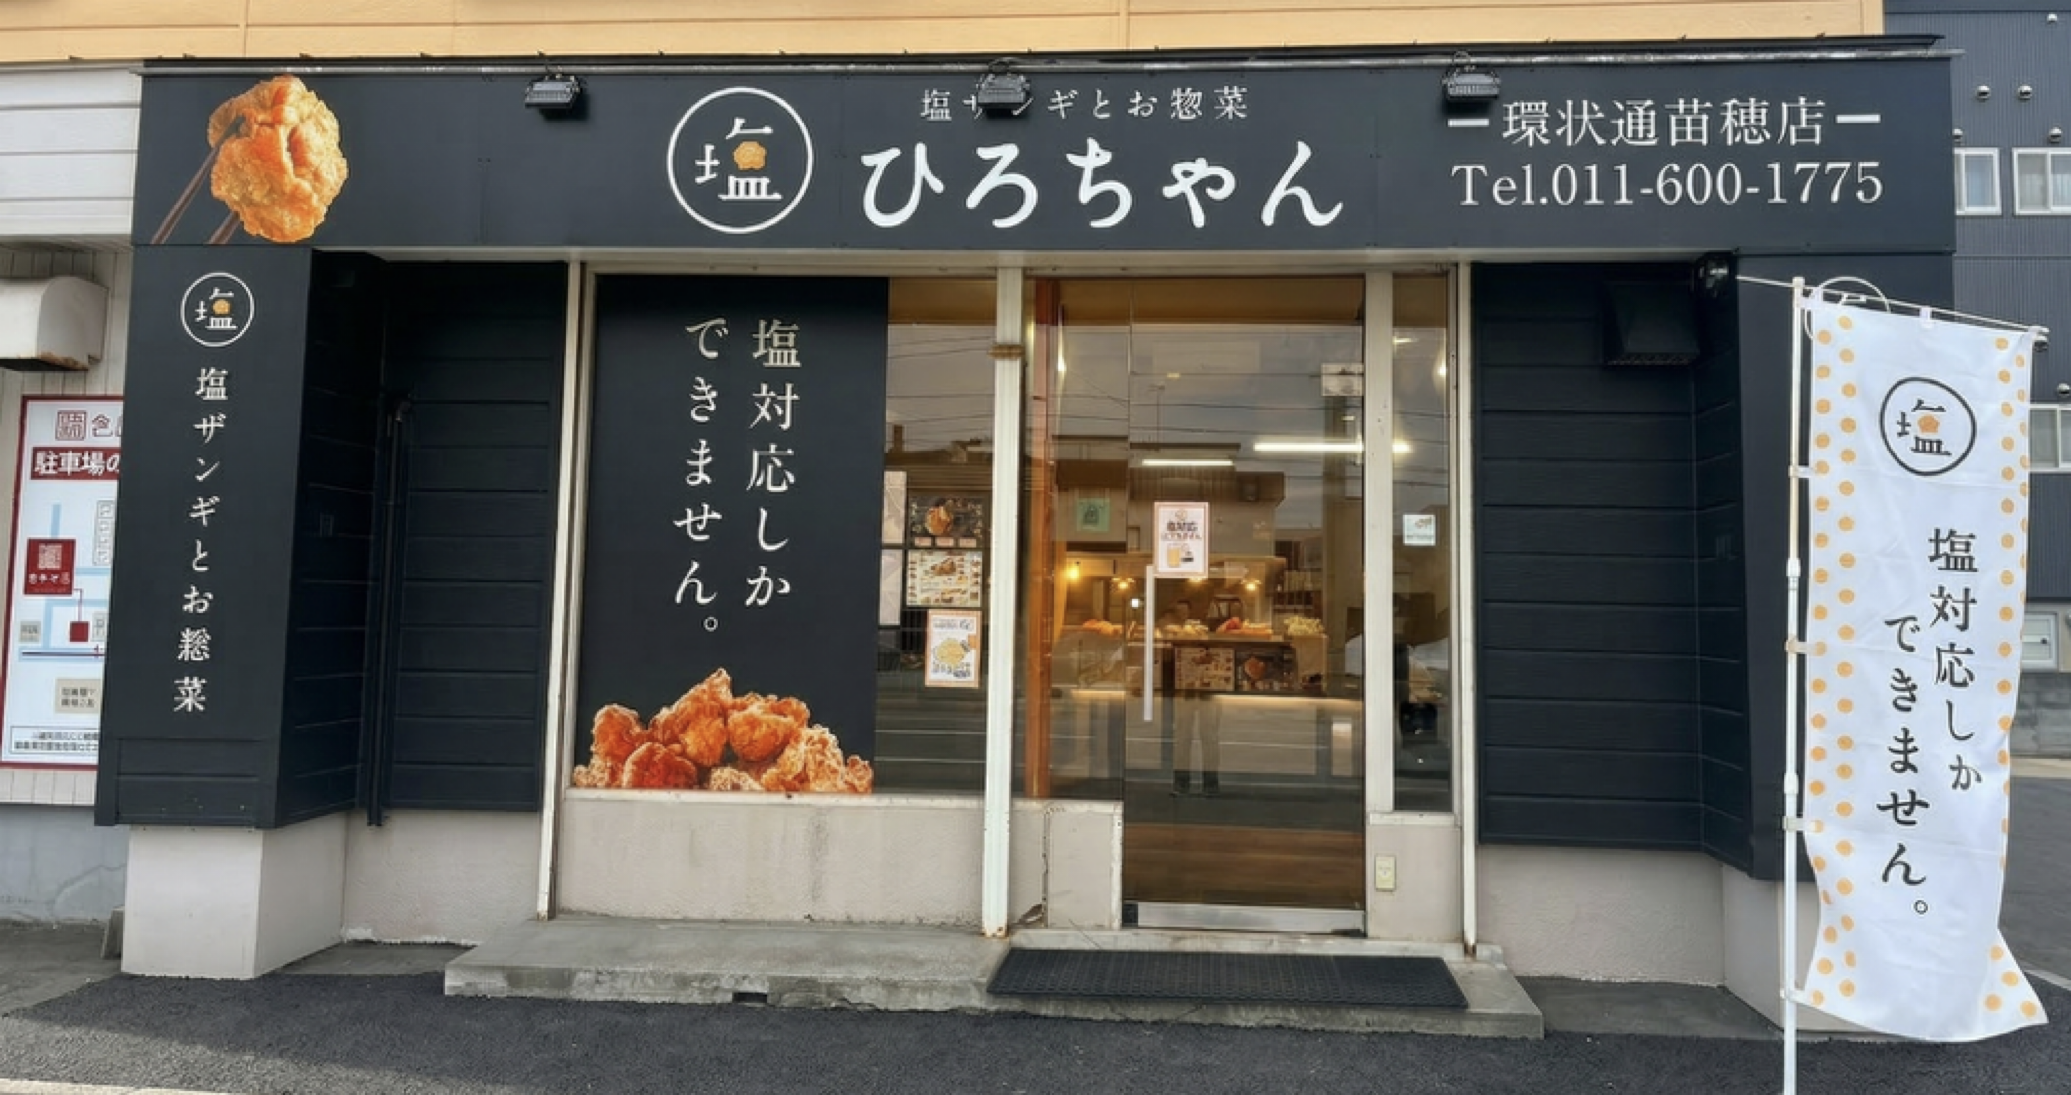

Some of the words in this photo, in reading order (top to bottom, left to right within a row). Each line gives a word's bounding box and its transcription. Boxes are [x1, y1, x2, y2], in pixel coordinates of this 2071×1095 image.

[695, 117, 783, 201] 塩
[860, 136, 1344, 229] ひろちゃん
[1451, 161, 1884, 206] Tel.011-600-1775
[673, 316, 730, 634] できません。
[745, 319, 802, 608] 塩対応しか
[1876, 612, 1931, 917] できません。
[1927, 526, 1983, 793] 塩対応しか
